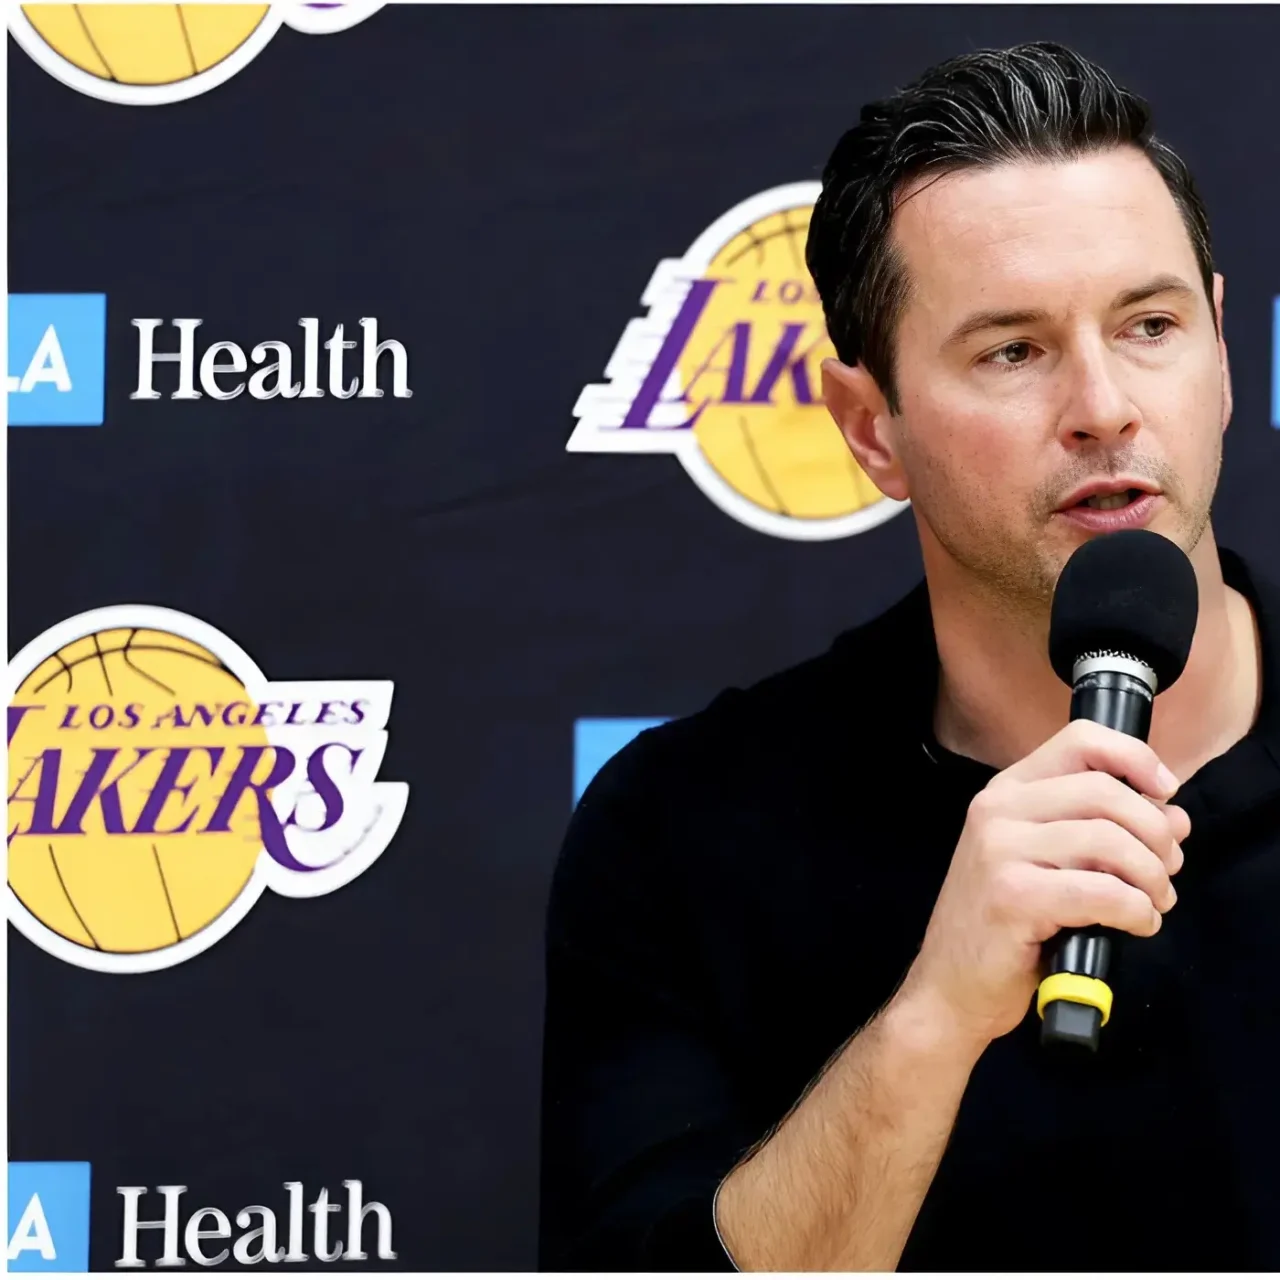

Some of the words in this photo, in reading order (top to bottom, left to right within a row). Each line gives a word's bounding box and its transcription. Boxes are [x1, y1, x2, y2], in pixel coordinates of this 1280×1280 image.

[129, 316, 414, 400] Health
[619, 278, 827, 430] LAK
[58, 702, 147, 731] LOS
[150, 700, 372, 730] ANGELES
[114, 1179, 399, 1268] Health
